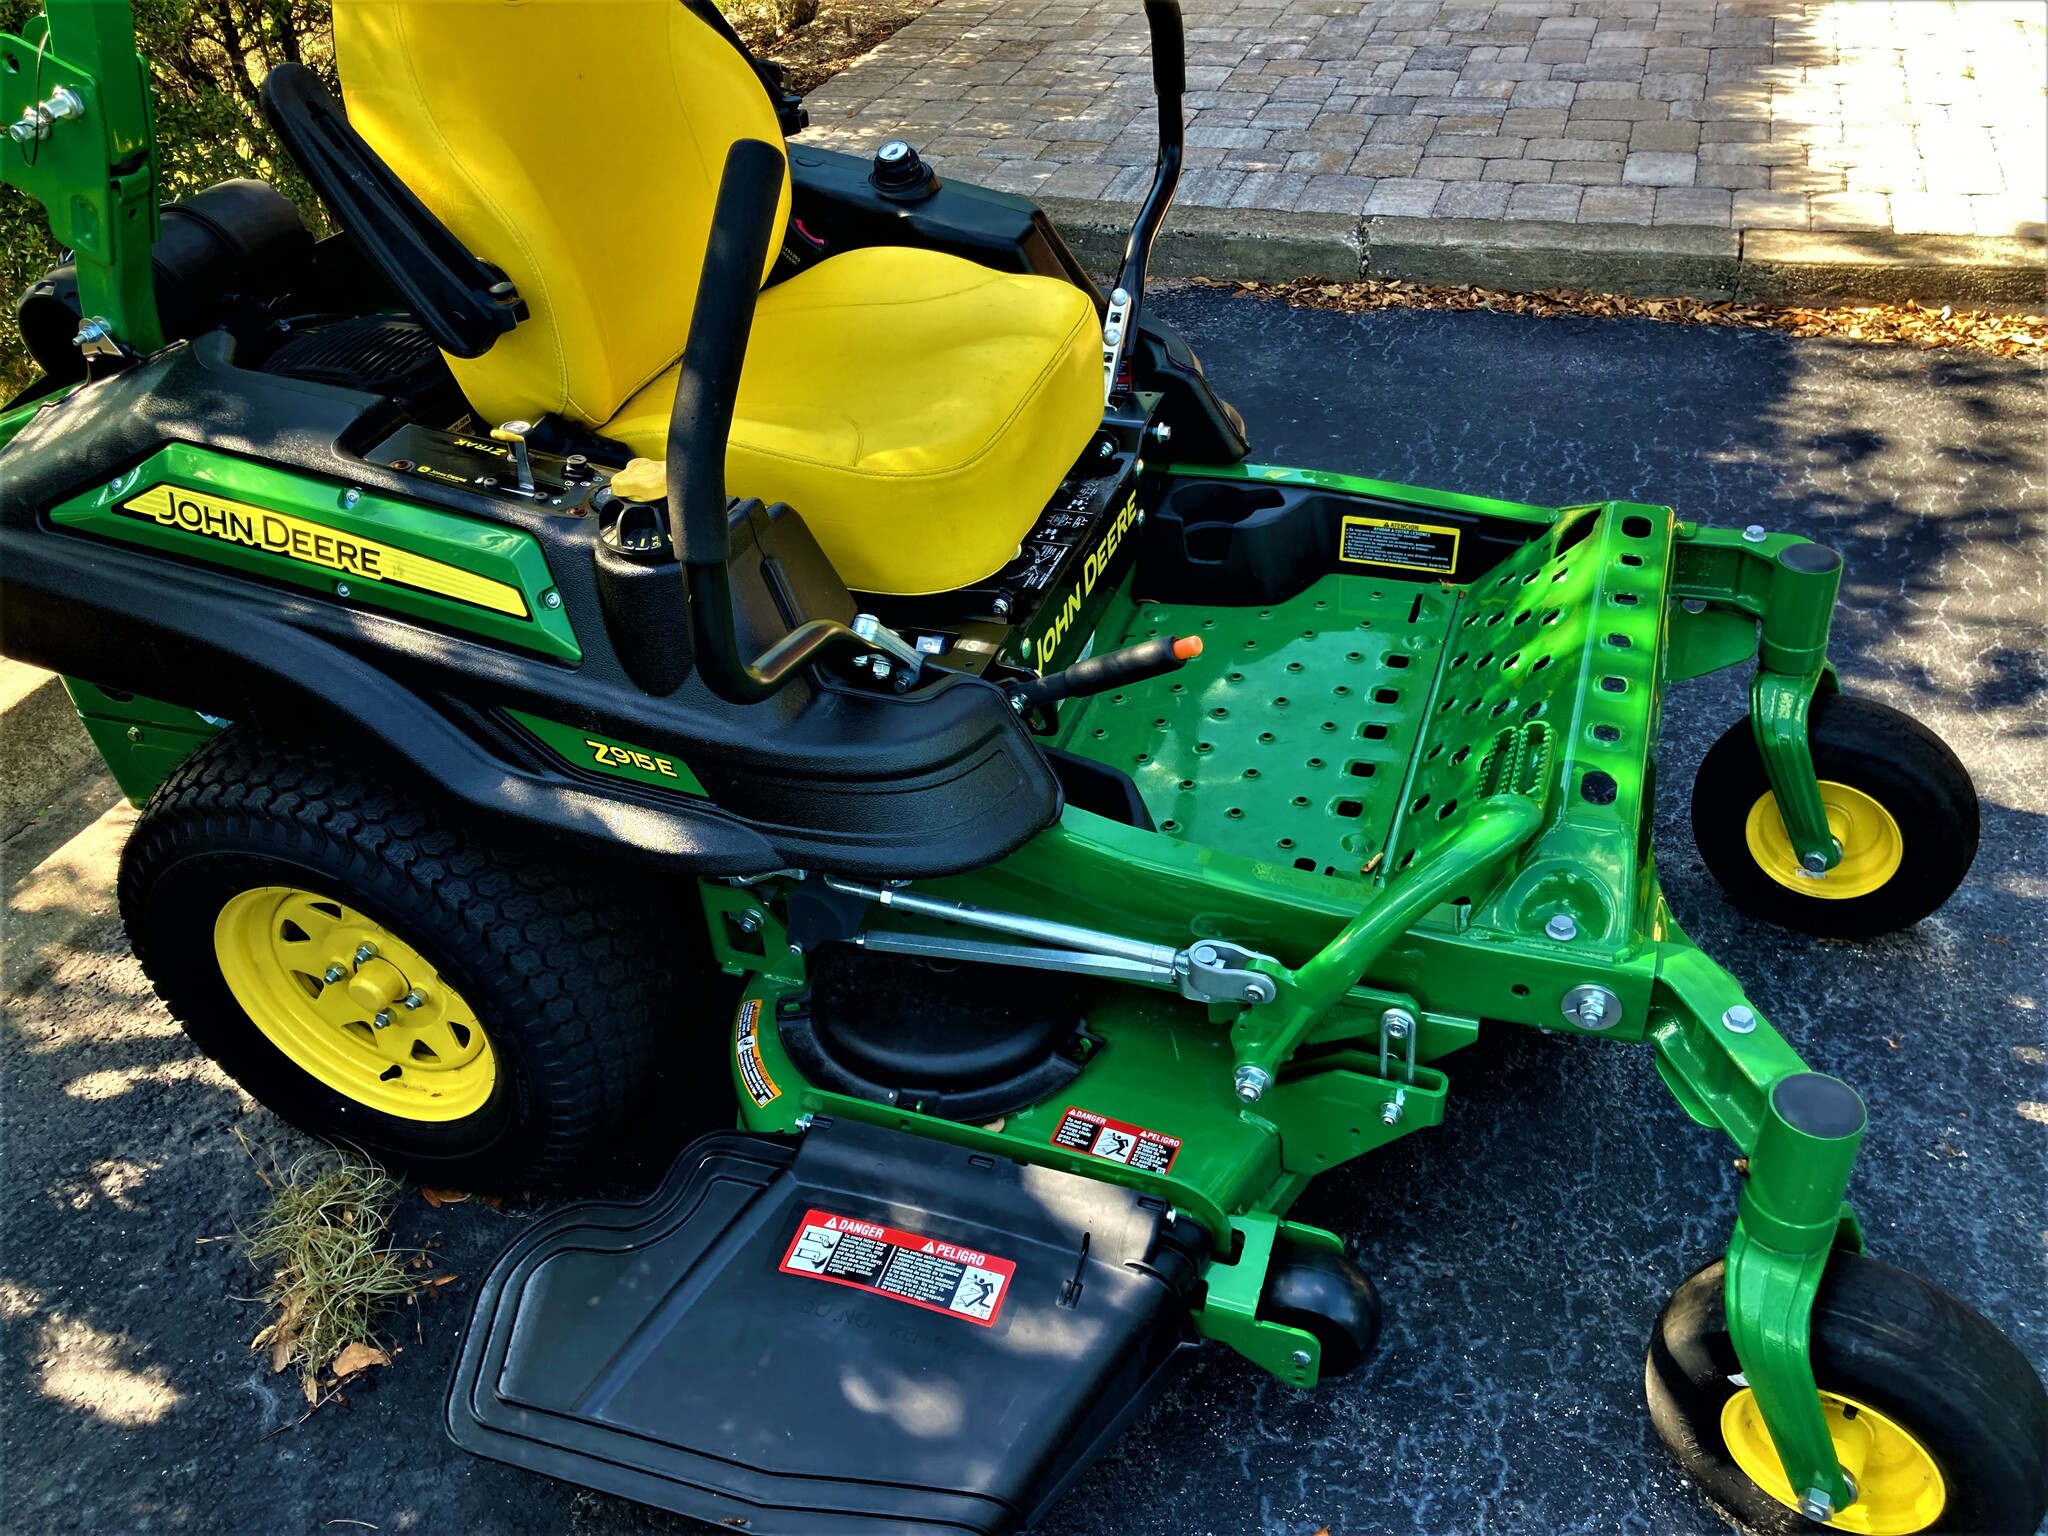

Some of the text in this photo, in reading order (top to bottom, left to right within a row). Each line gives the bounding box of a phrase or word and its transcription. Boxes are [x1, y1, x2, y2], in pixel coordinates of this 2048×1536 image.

[454, 438, 507, 456] ZTRAK
[158, 492, 382, 576] JOHN DEERE
[1036, 582, 1082, 674] JOHN
[1084, 489, 1137, 598] DEERE
[586, 740, 678, 777] Z915E
[1076, 1110, 1107, 1125] DANGER
[1146, 1133, 1180, 1147] PELIGRO
[839, 1220, 884, 1239] DANGER
[936, 1244, 985, 1267] PELIGRO
